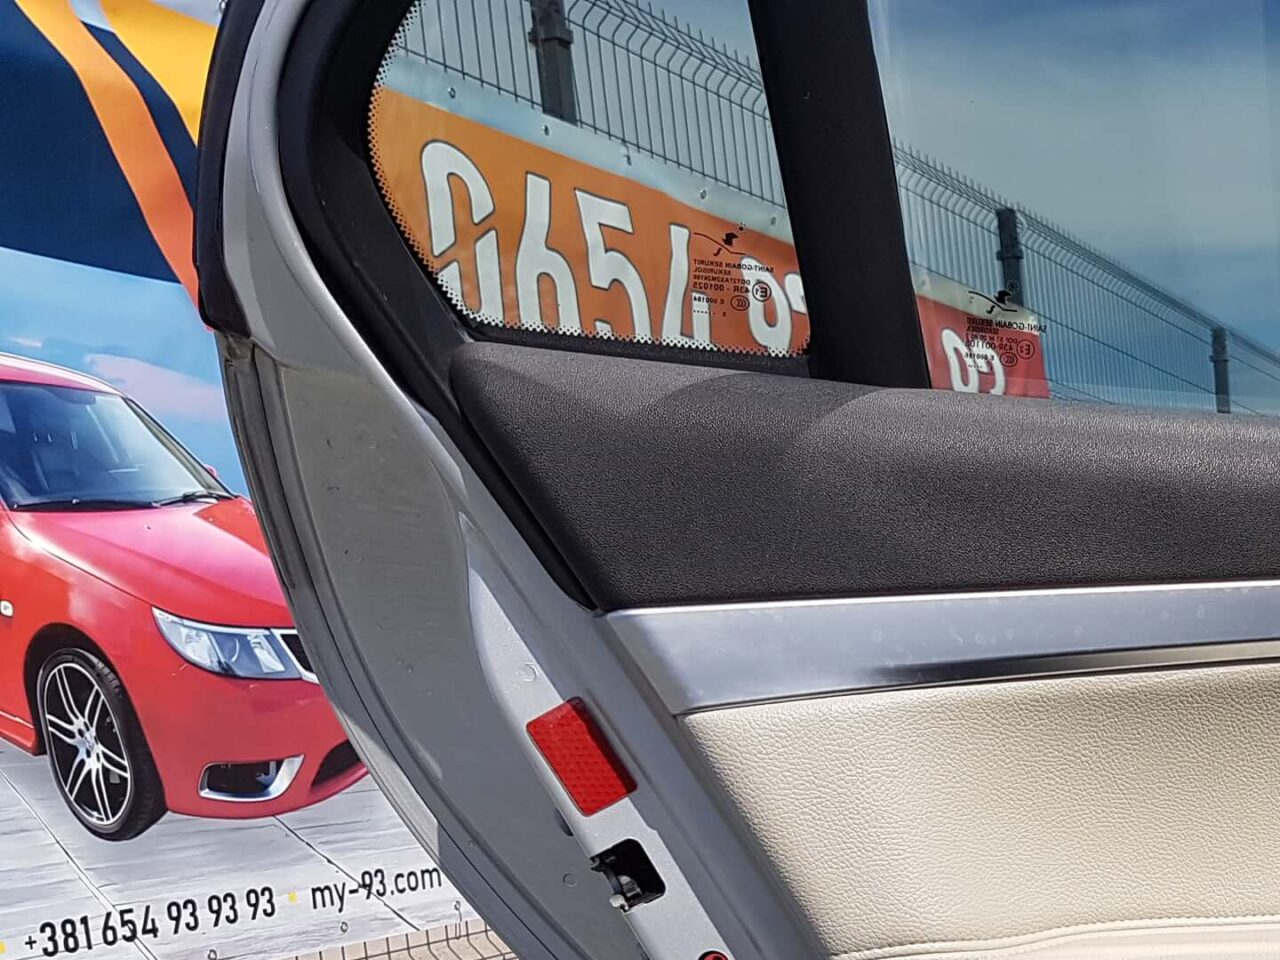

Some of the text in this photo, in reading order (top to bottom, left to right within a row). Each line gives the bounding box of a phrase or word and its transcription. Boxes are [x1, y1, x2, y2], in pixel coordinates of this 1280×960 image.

[25, 867, 442, 957] +381 654 93 93 93 my-93.com
